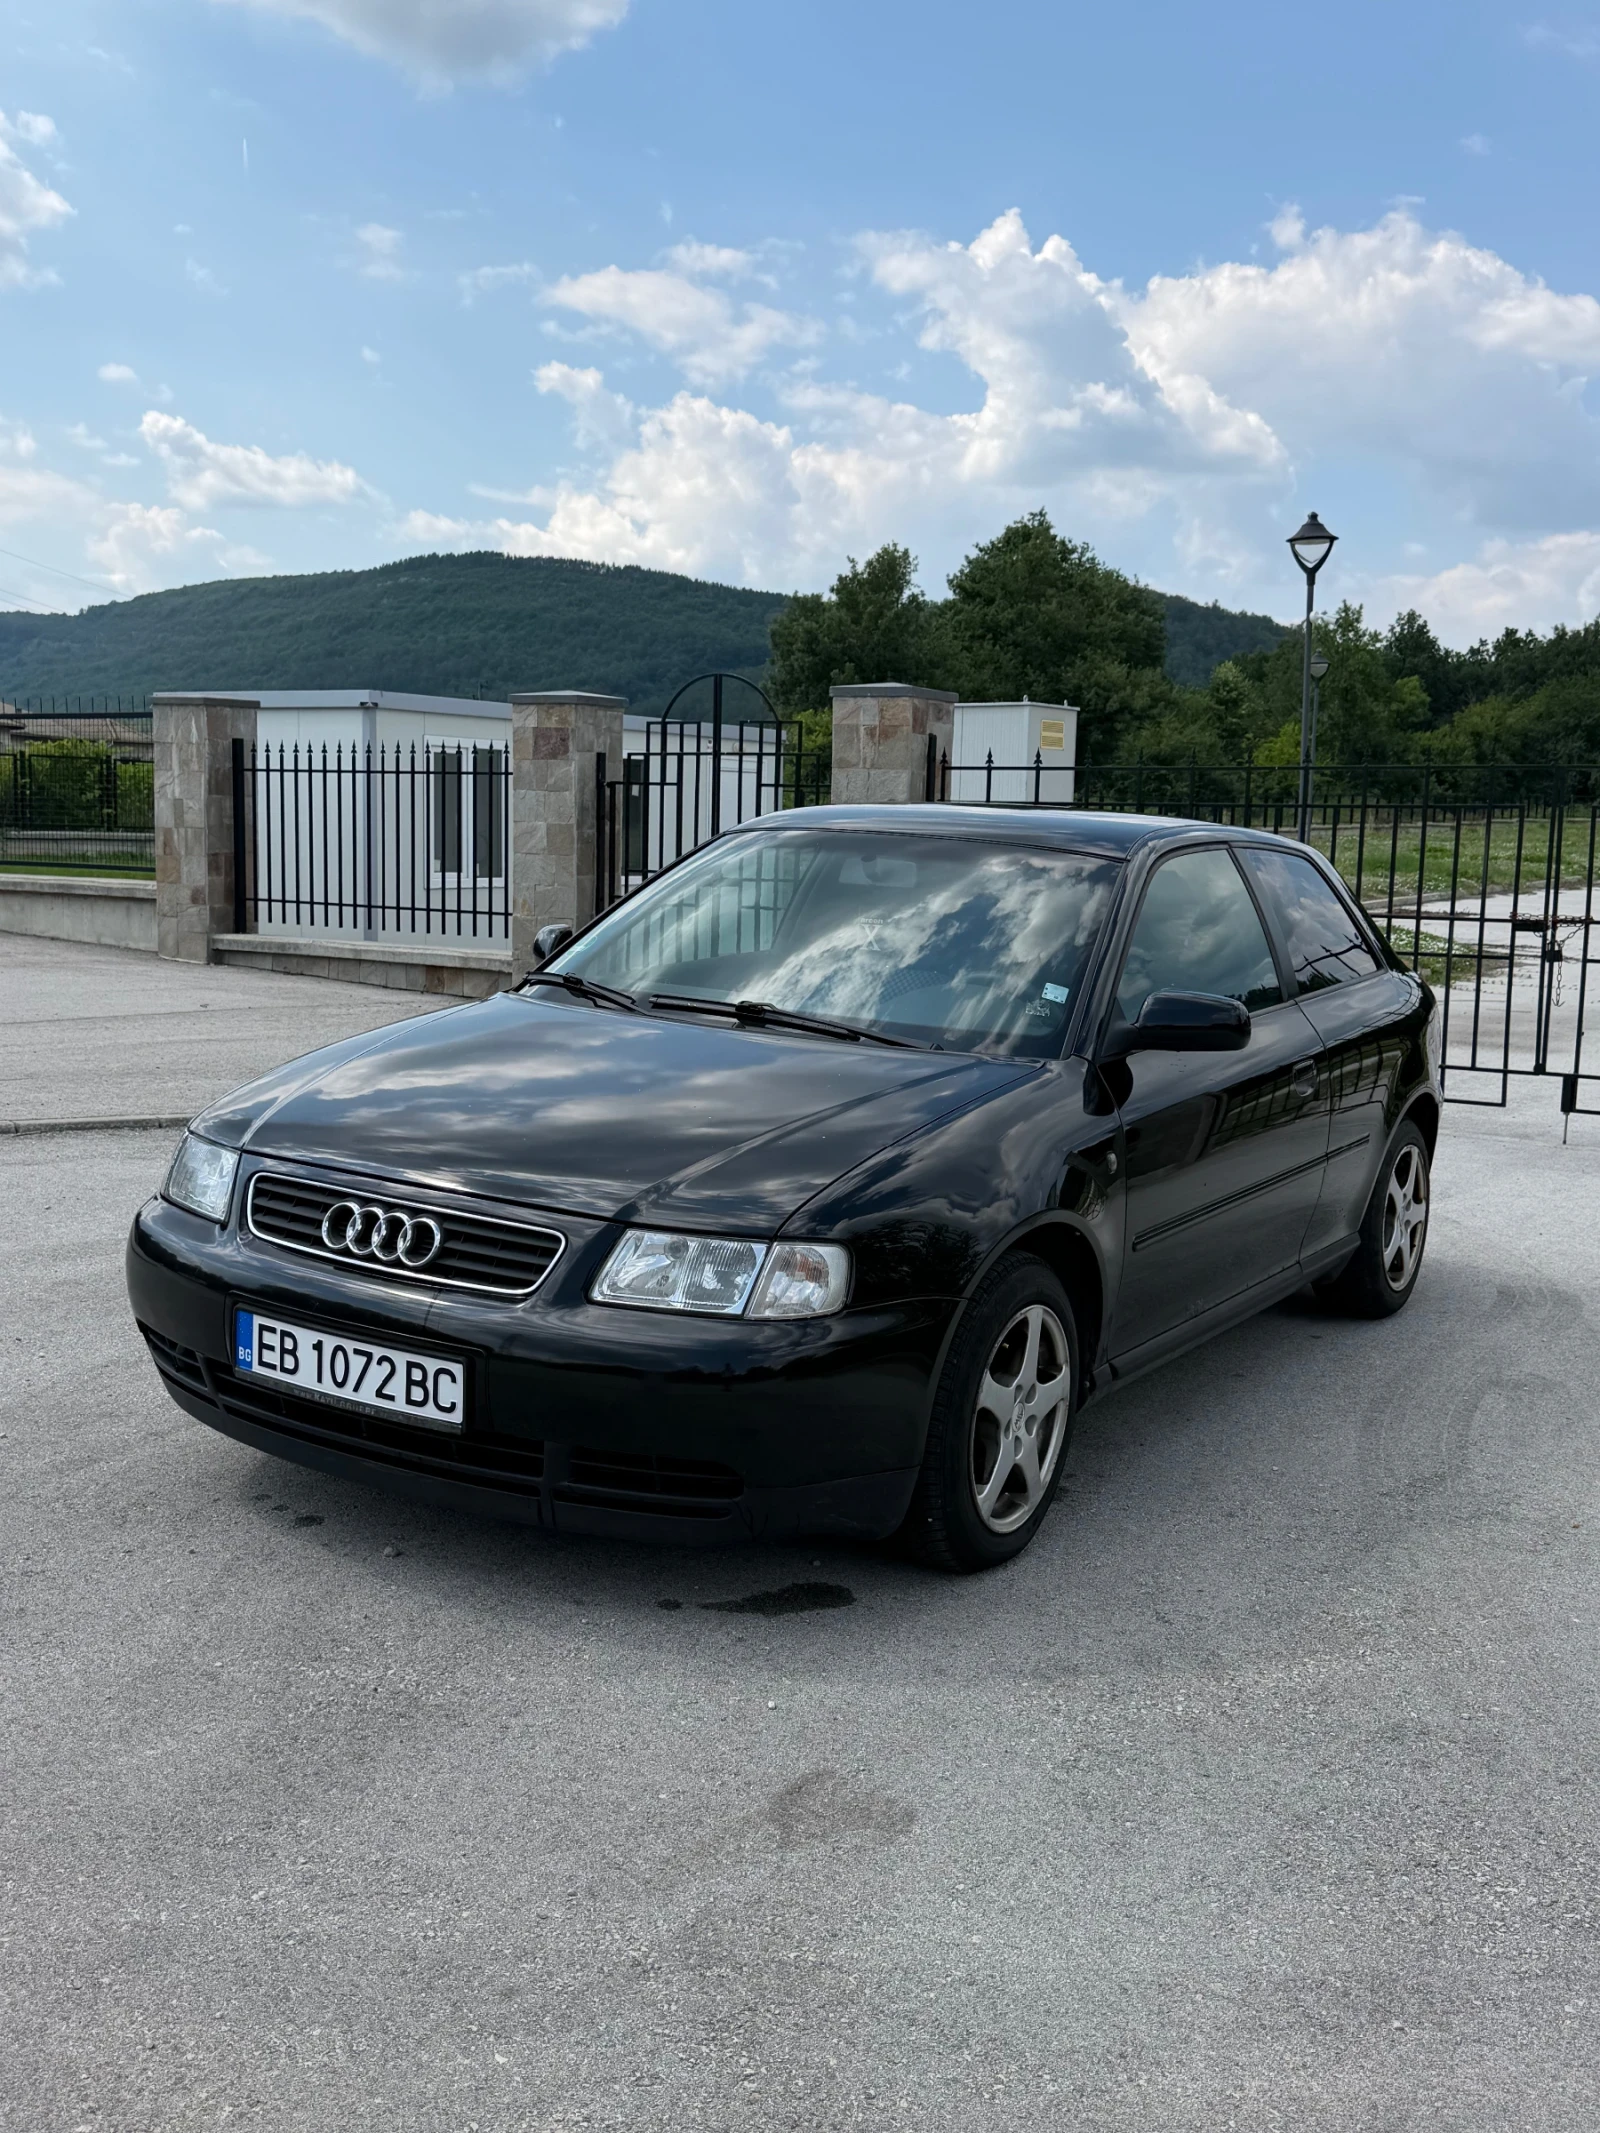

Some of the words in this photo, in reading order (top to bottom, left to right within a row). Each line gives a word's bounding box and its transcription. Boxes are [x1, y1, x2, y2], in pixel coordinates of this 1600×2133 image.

[860, 924, 883, 951] X
[238, 1346, 252, 1362] BG
[258, 1323, 299, 1375] EB
[312, 1339, 396, 1402] 1072
[405, 1360, 457, 1413] BC
